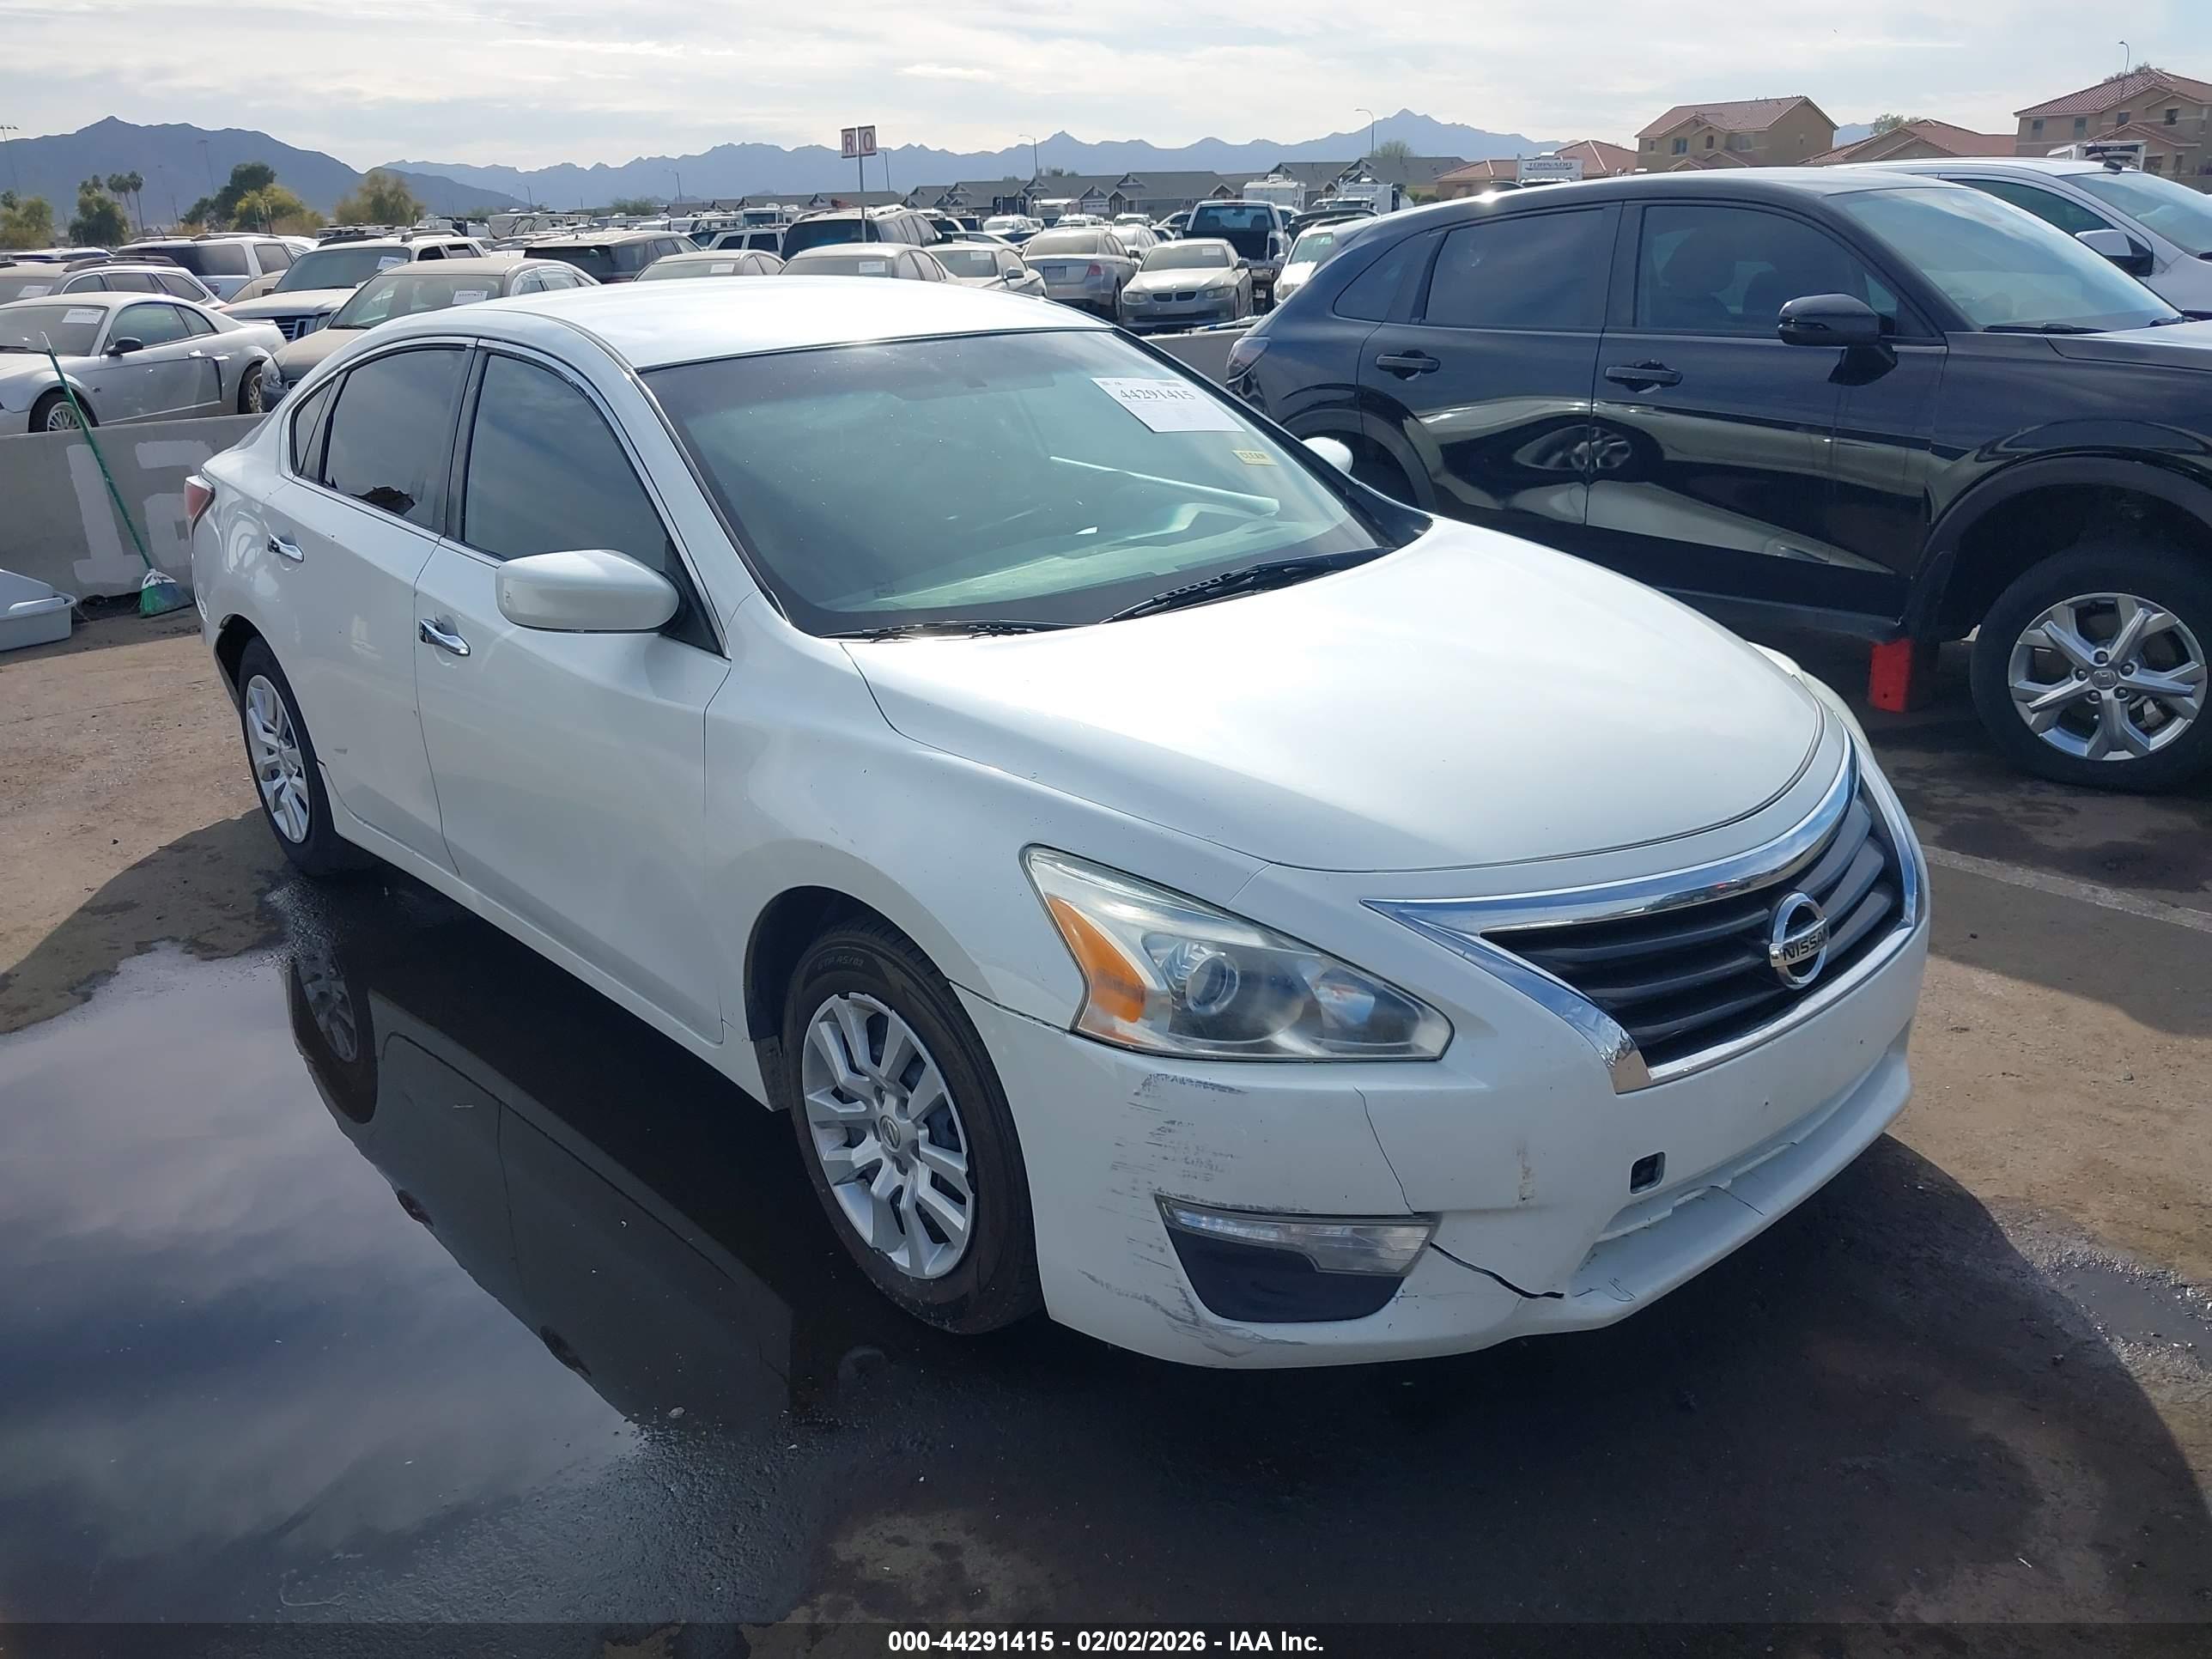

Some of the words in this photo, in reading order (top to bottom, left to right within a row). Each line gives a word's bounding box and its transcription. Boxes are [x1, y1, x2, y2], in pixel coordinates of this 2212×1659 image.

[844, 134, 854, 153] R
[1119, 388, 1196, 400] 44291415
[1783, 927, 1827, 961] NISSAN
